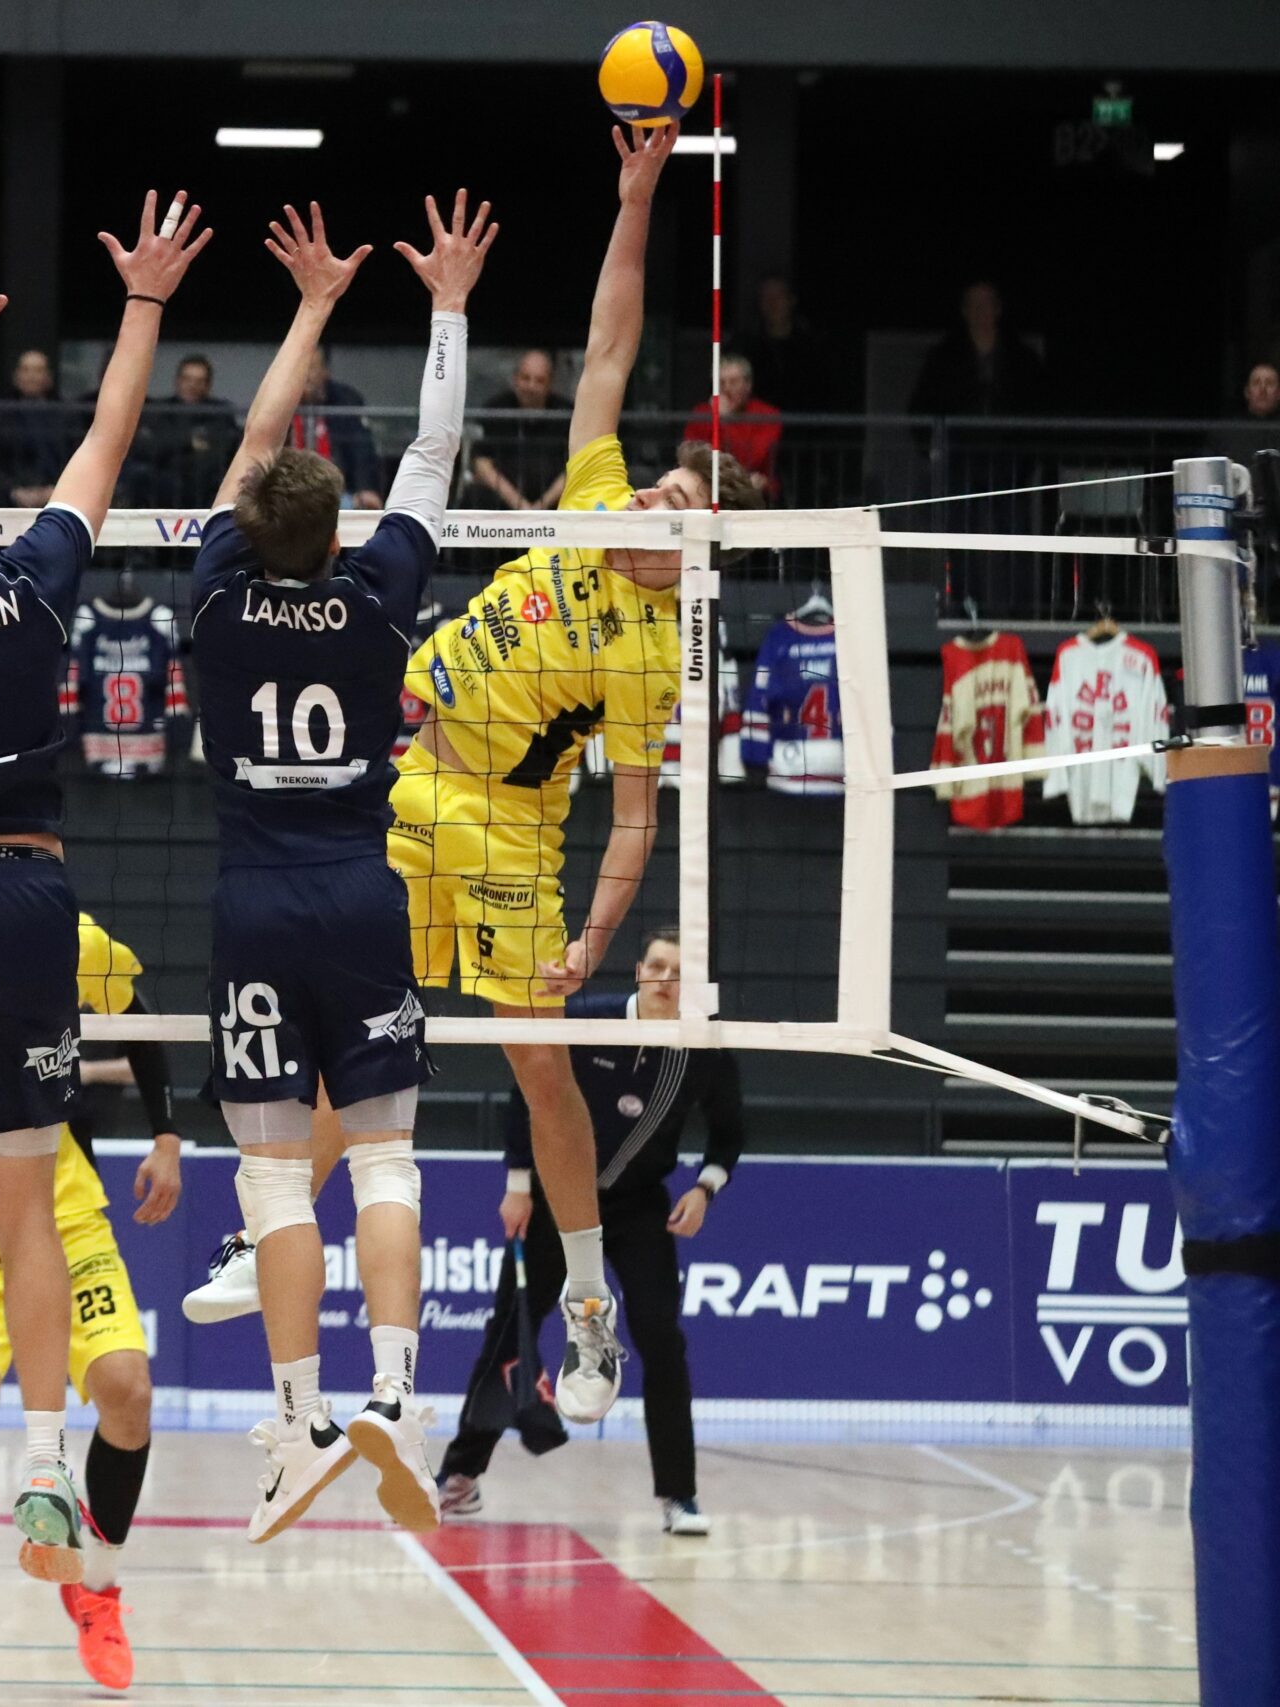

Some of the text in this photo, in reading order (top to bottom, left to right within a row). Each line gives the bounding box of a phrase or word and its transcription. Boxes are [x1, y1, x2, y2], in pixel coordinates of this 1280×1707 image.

[435, 340, 447, 381] CRAFT
[441, 524, 556, 539] afé Muonamanta
[242, 588, 348, 632] LAAKSO
[497, 588, 521, 650] VALLOX
[469, 636, 494, 674] GROUP
[103, 672, 145, 731] 8
[250, 681, 347, 761] 10
[275, 775, 329, 786] TREKOVAN
[220, 981, 283, 1030] JO
[222, 1028, 299, 1079] KI.
[76, 1285, 117, 1324] 23
[679, 1263, 910, 1318] RAFT
[403, 1346, 412, 1381] CRAFT
[1039, 1326, 1191, 1386] VO
[282, 1379, 294, 1412] CRAFT
